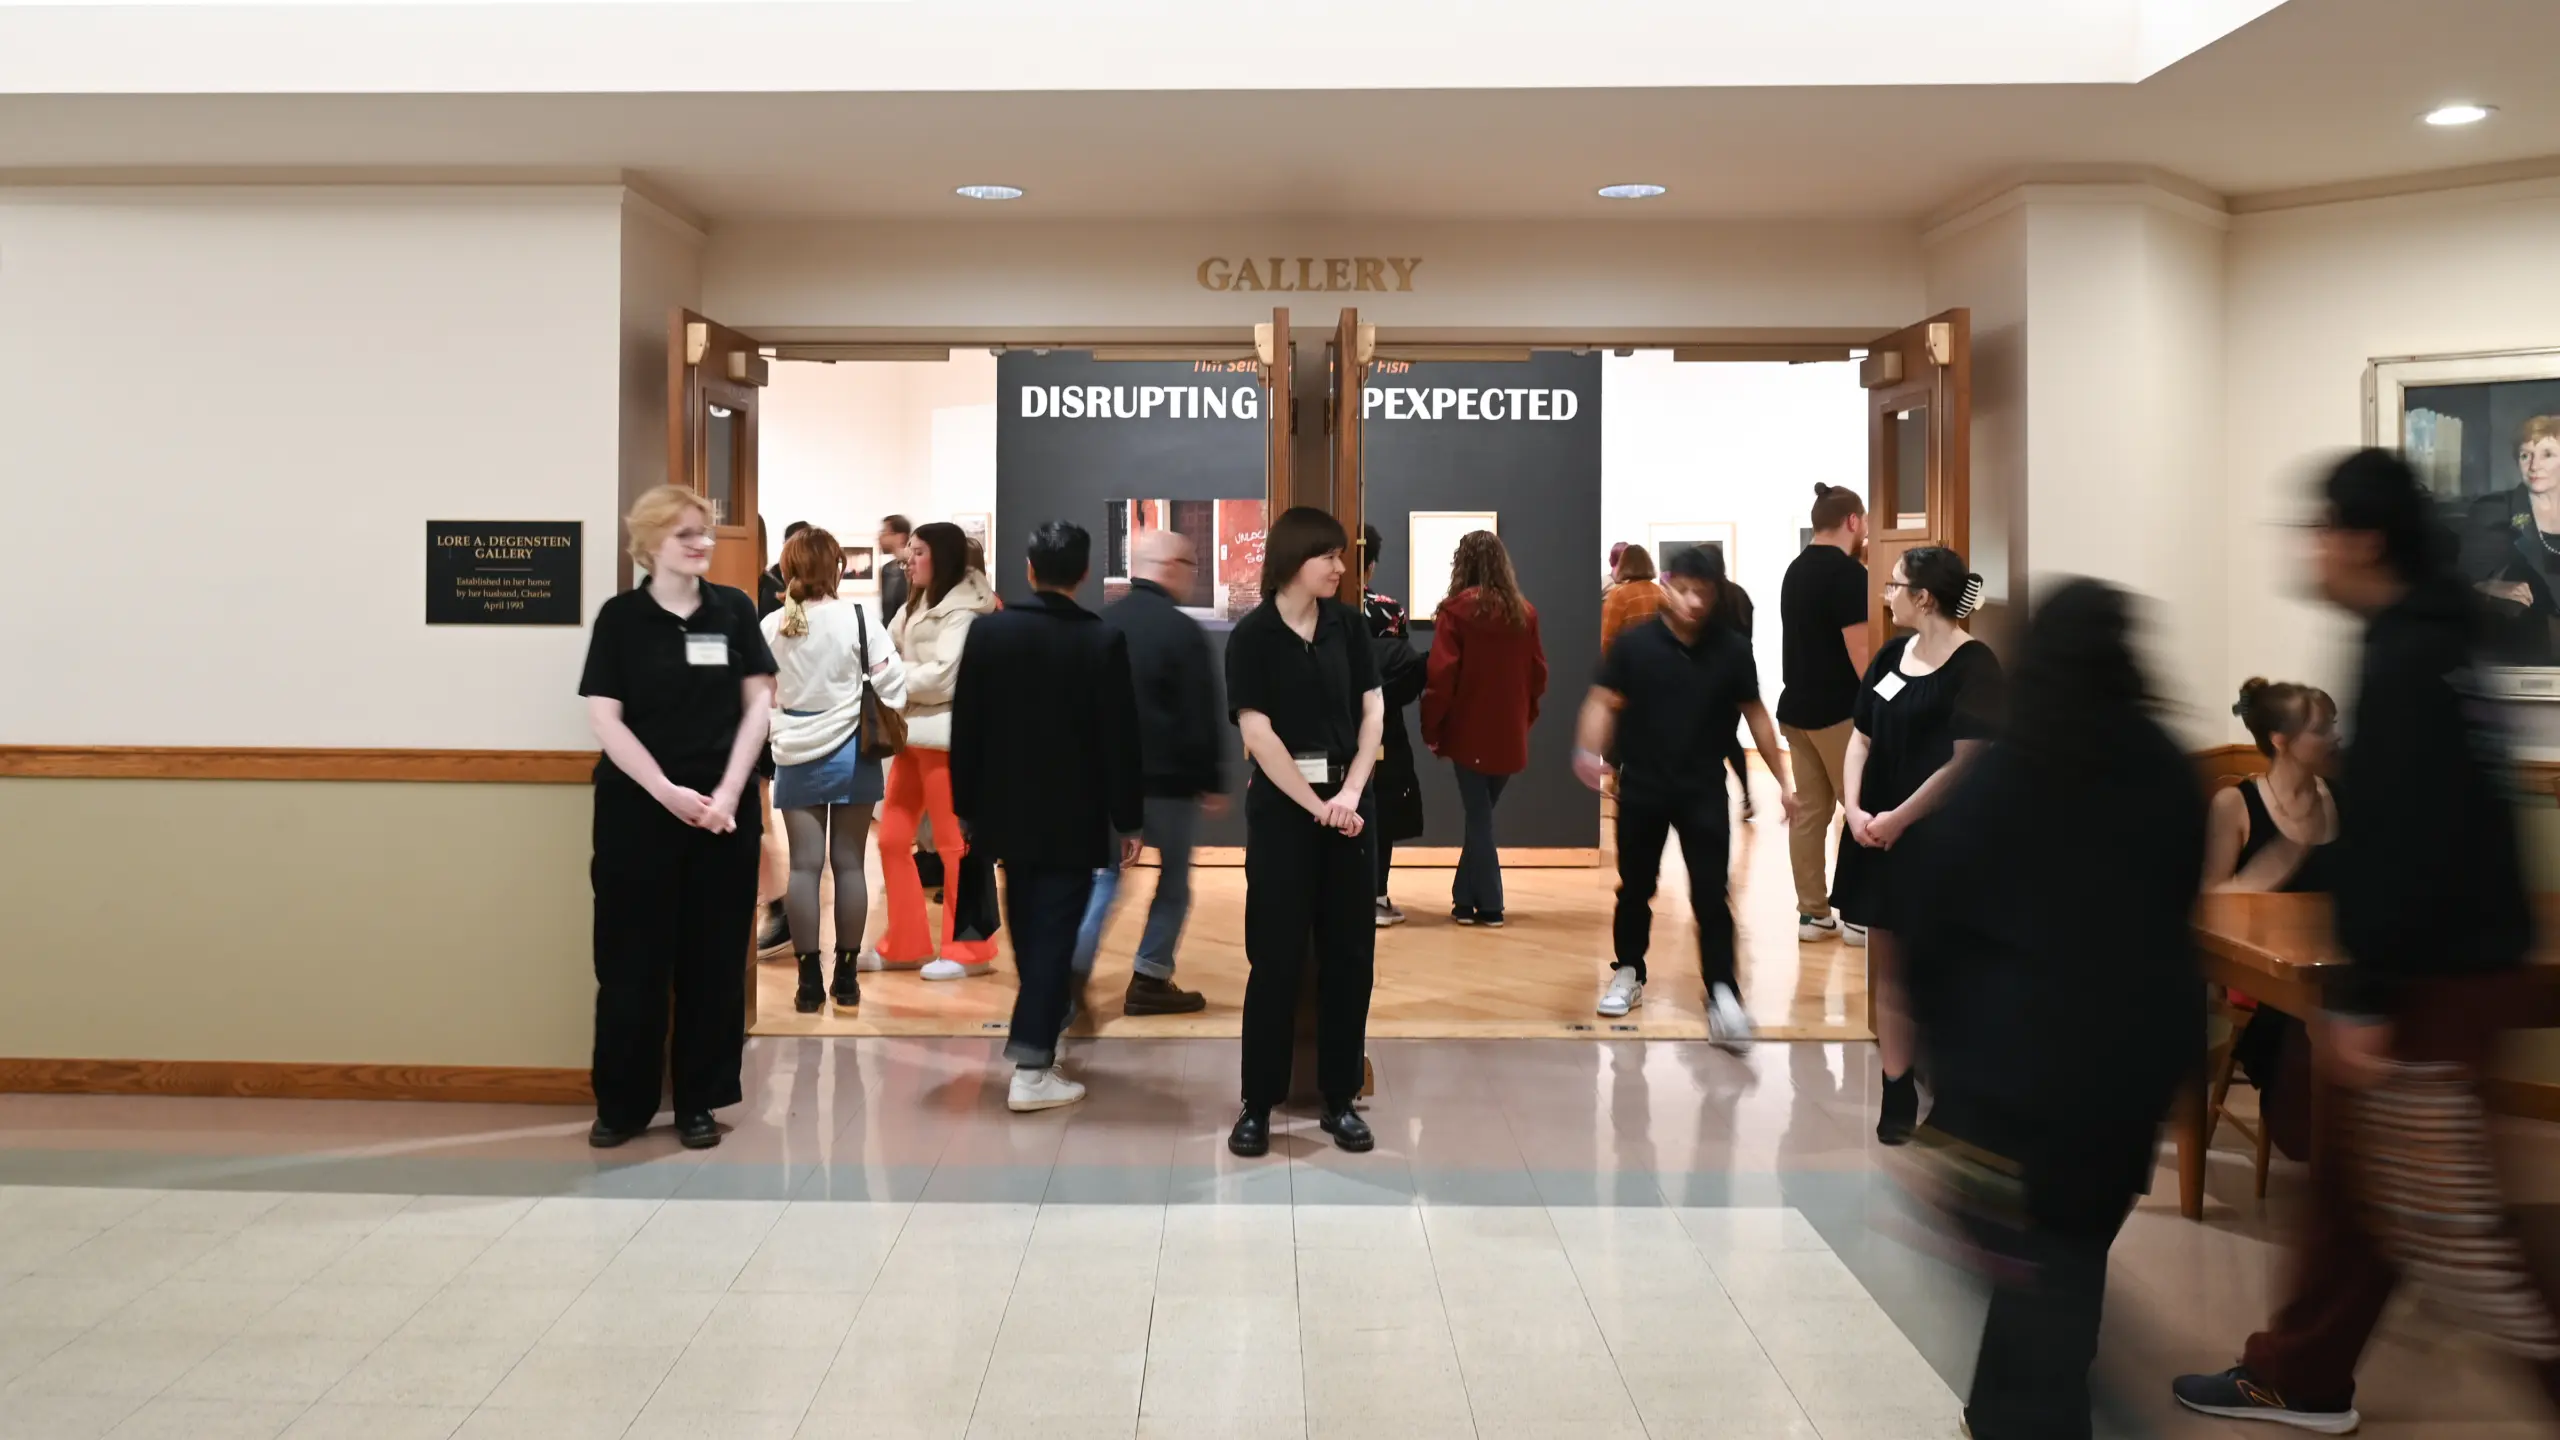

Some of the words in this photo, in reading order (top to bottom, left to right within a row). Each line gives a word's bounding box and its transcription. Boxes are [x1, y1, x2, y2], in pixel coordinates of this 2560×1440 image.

[1196, 256, 1423, 292] GALLERY
[1377, 360, 1410, 374] Fish
[1020, 386, 1258, 419] DISRUPTING
[1357, 387, 1579, 420] PEXPECTED
[436, 536, 470, 547] LORE
[474, 536, 486, 547] A.
[489, 536, 571, 547] DEGENSTEIN
[1235, 529, 1267, 544] UNLOC
[475, 548, 533, 559] GALLERY
[456, 577, 501, 586] Established
[503, 577, 511, 586] in
[512, 577, 525, 586] her
[528, 577, 551, 587] honor
[456, 589, 466, 599] by
[468, 589, 481, 597] her
[483, 589, 519, 599] husband,
[521, 589, 551, 598] Charles
[484, 601, 504, 611] April
